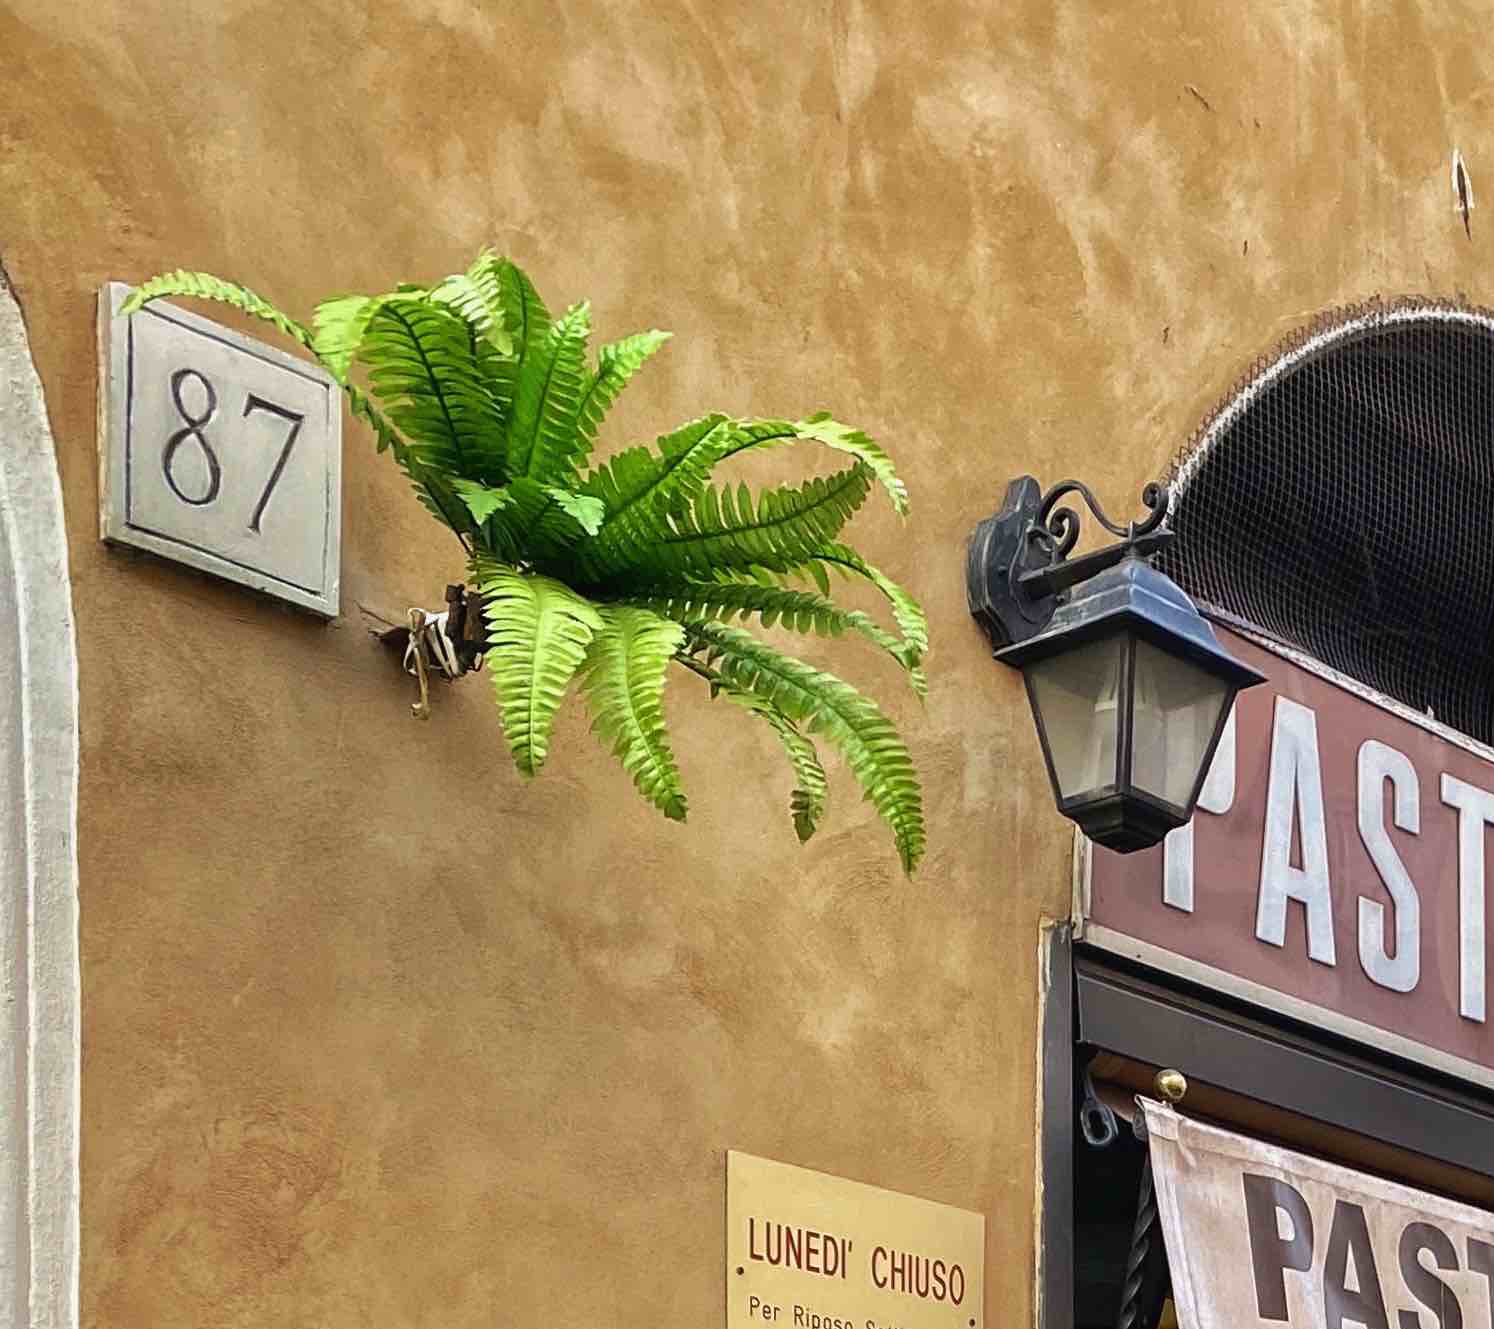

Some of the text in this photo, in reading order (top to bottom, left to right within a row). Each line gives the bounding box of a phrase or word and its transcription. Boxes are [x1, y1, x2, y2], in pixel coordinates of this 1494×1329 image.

[161, 367, 306, 536] 87
[749, 1217, 966, 1306] LUNEDI' CHIUSO
[749, 1295, 780, 1321] Per
